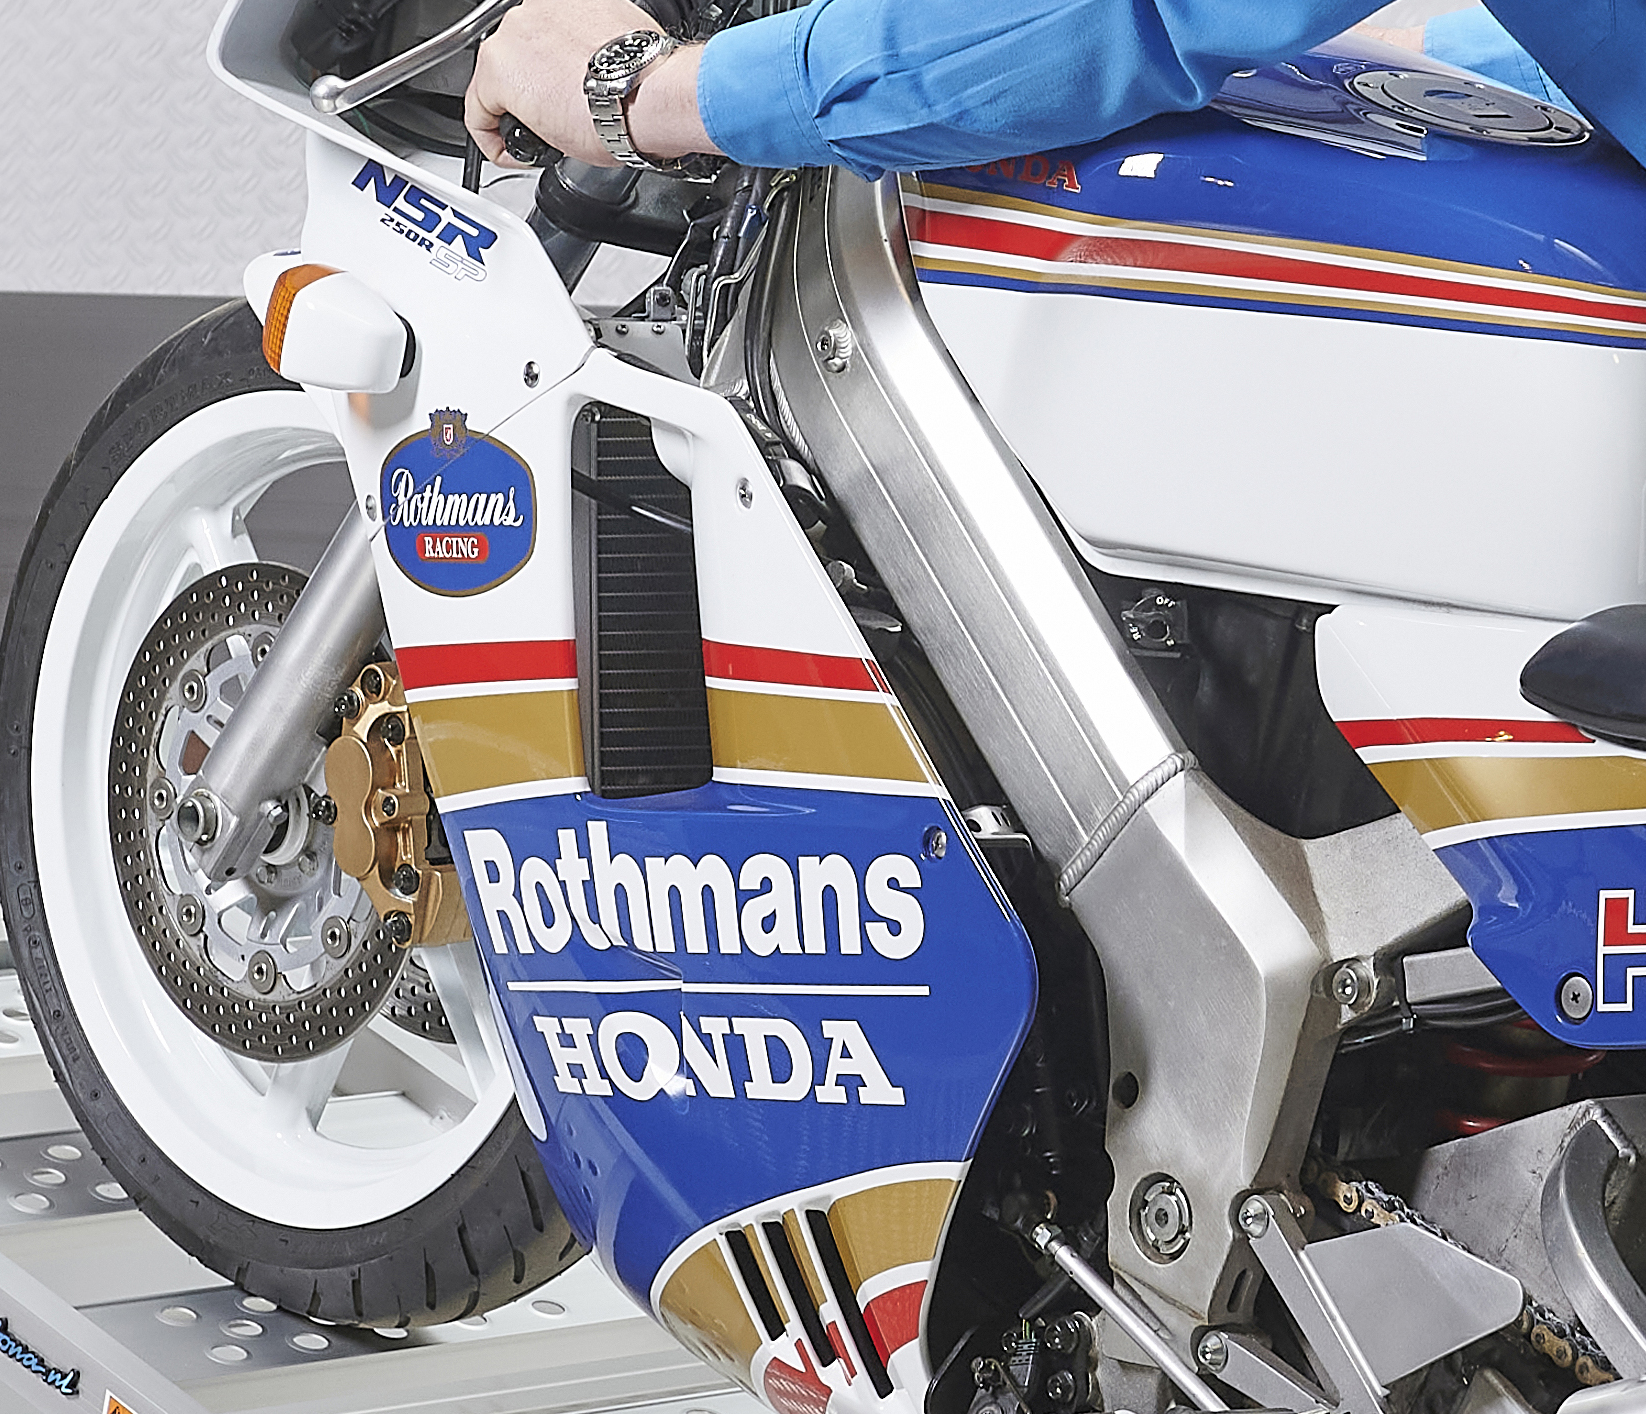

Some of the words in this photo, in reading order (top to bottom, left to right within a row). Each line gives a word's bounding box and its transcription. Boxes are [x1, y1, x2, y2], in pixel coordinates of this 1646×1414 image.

[966, 153, 1081, 194] NDA
[352, 158, 498, 266] NSR
[380, 213, 434, 253] 250R
[429, 245, 487, 282] SP
[389, 467, 524, 527] Rothmans
[423, 536, 480, 560] RACING
[463, 820, 926, 960] Rothmans
[535, 1010, 906, 1106] HONDA
